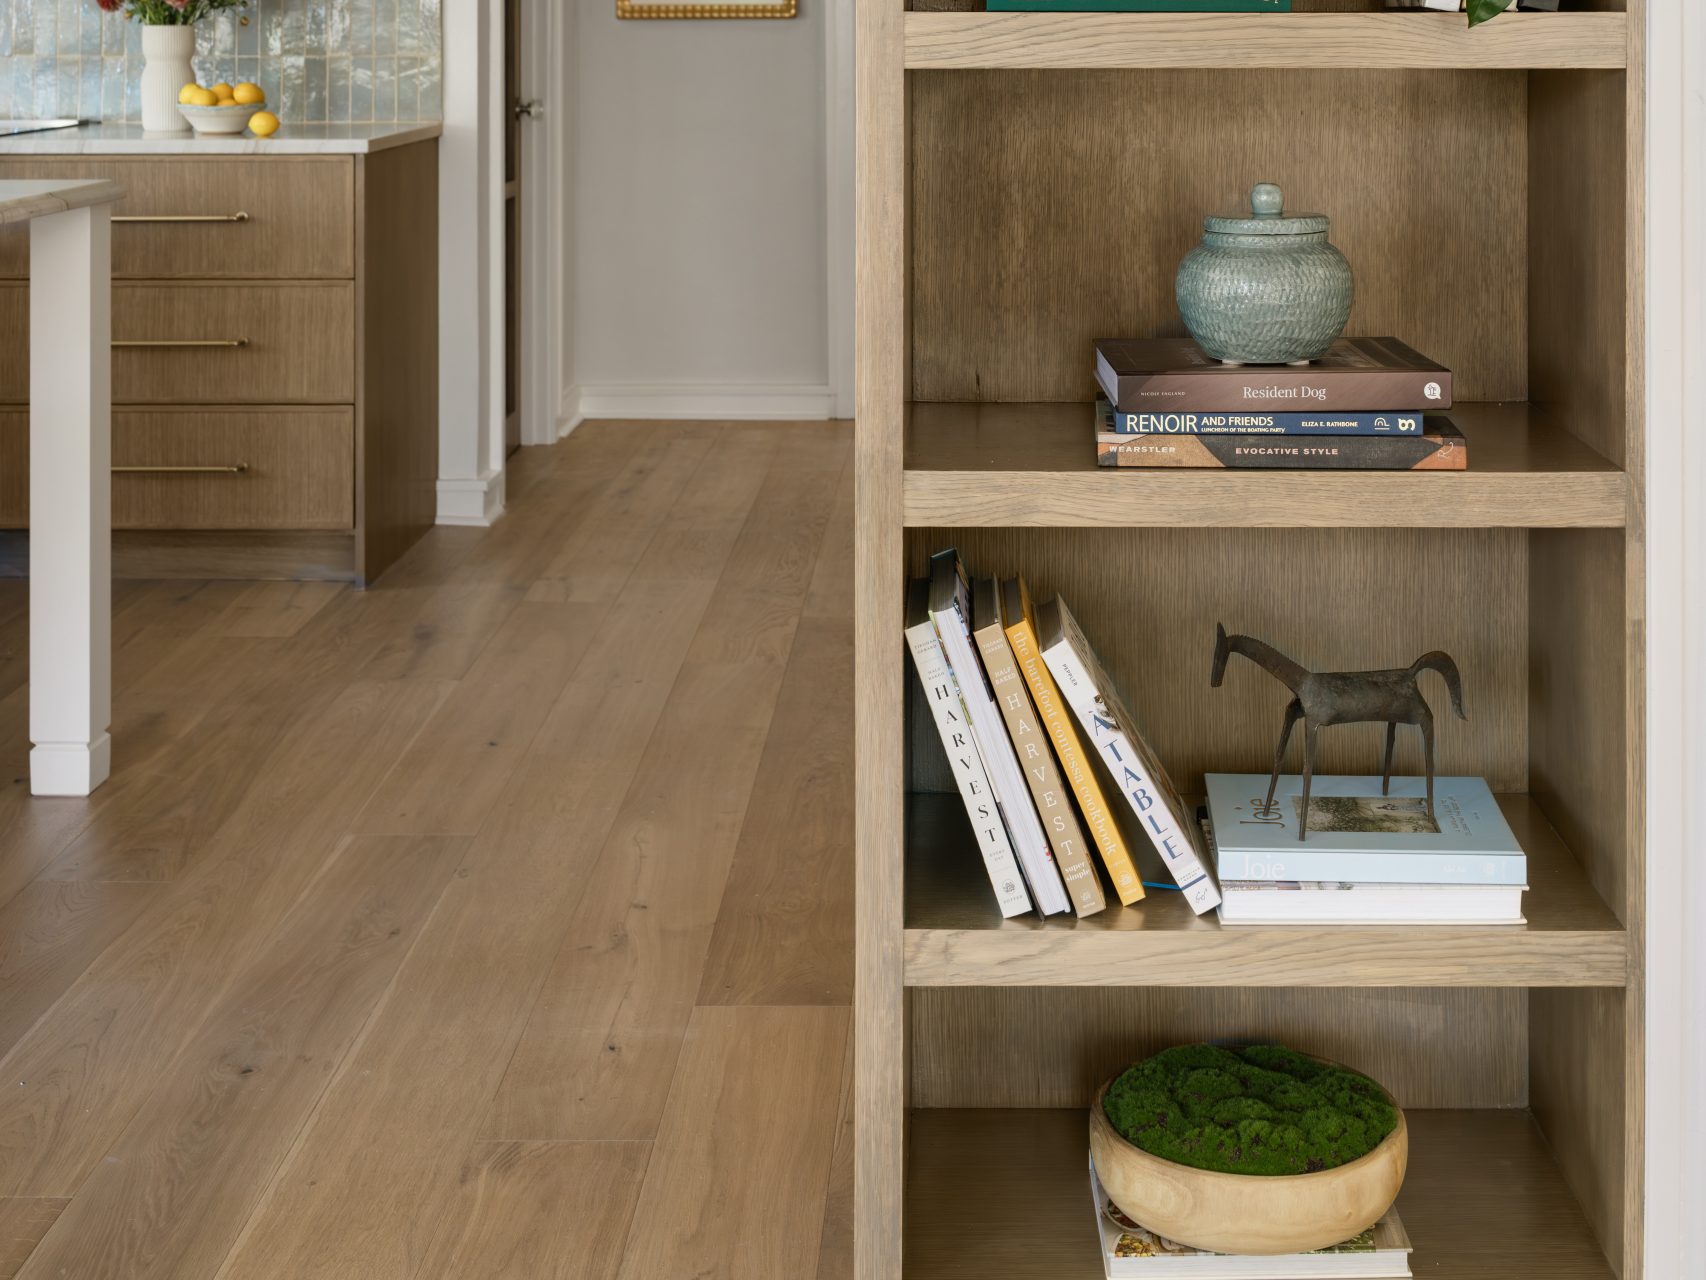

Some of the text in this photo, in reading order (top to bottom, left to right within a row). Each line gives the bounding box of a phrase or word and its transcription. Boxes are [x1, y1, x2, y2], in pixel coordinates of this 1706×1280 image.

[1243, 386, 1326, 400] Resident Dog
[1126, 414, 1274, 433] RENOIR AND FRIENDS
[1235, 447, 1299, 455] EVOCATIVE
[994, 666, 1012, 678] HALF
[995, 672, 1017, 685] BAKED
[1062, 663, 1078, 686] PEPPLER
[1013, 631, 1118, 856] the barefoot contessa cookbook
[934, 684, 997, 842] HARVEST
[1005, 692, 1074, 856] HARVEST
[1103, 738, 1184, 860] TABLE
[1065, 861, 1086, 874] super
[1066, 868, 1091, 881] simple
[1240, 853, 1285, 879] Joie
